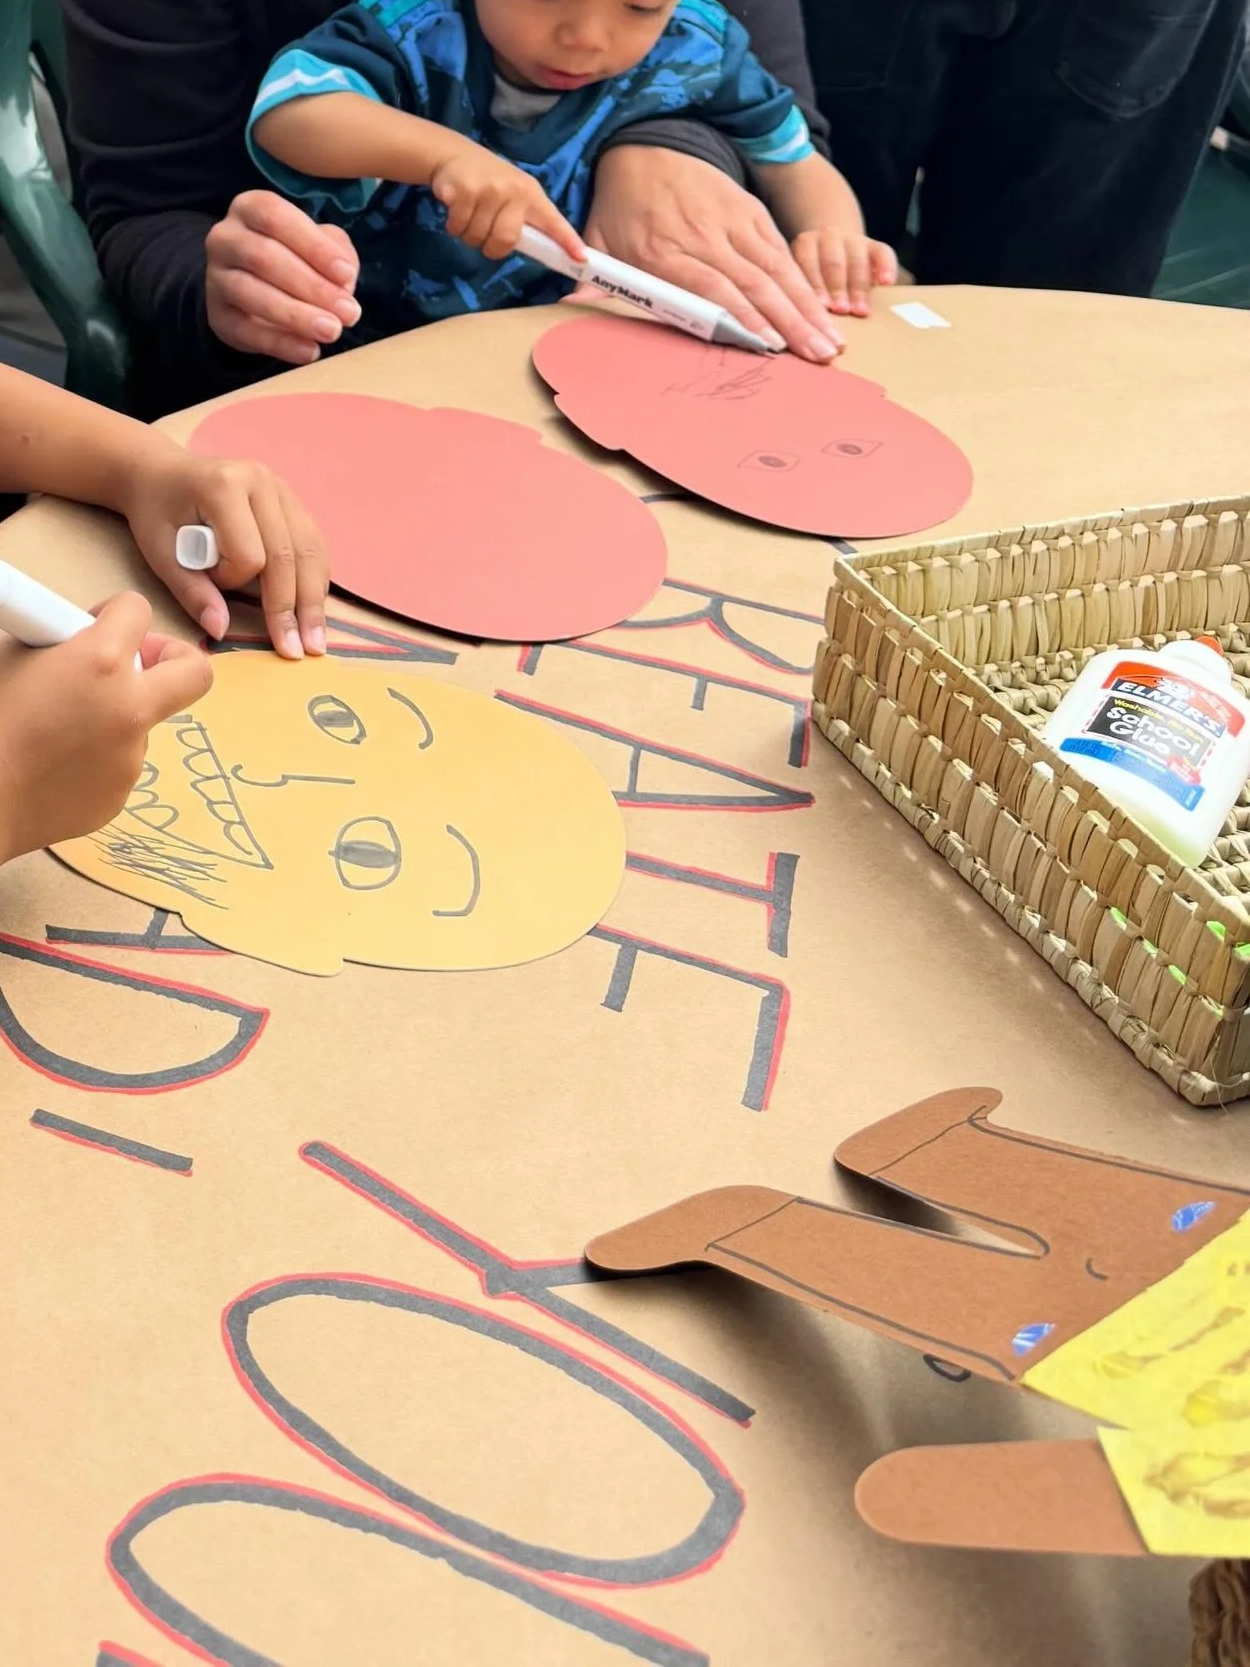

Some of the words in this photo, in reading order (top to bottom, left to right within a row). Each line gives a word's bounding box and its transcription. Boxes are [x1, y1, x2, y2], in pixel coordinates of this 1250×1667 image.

[592, 275, 654, 309] AnyMark
[1106, 706, 1201, 756] School
[1116, 682, 1222, 732] ELMER'S
[1110, 721, 1171, 755] Glue
[496, 492, 858, 1112] REATE
